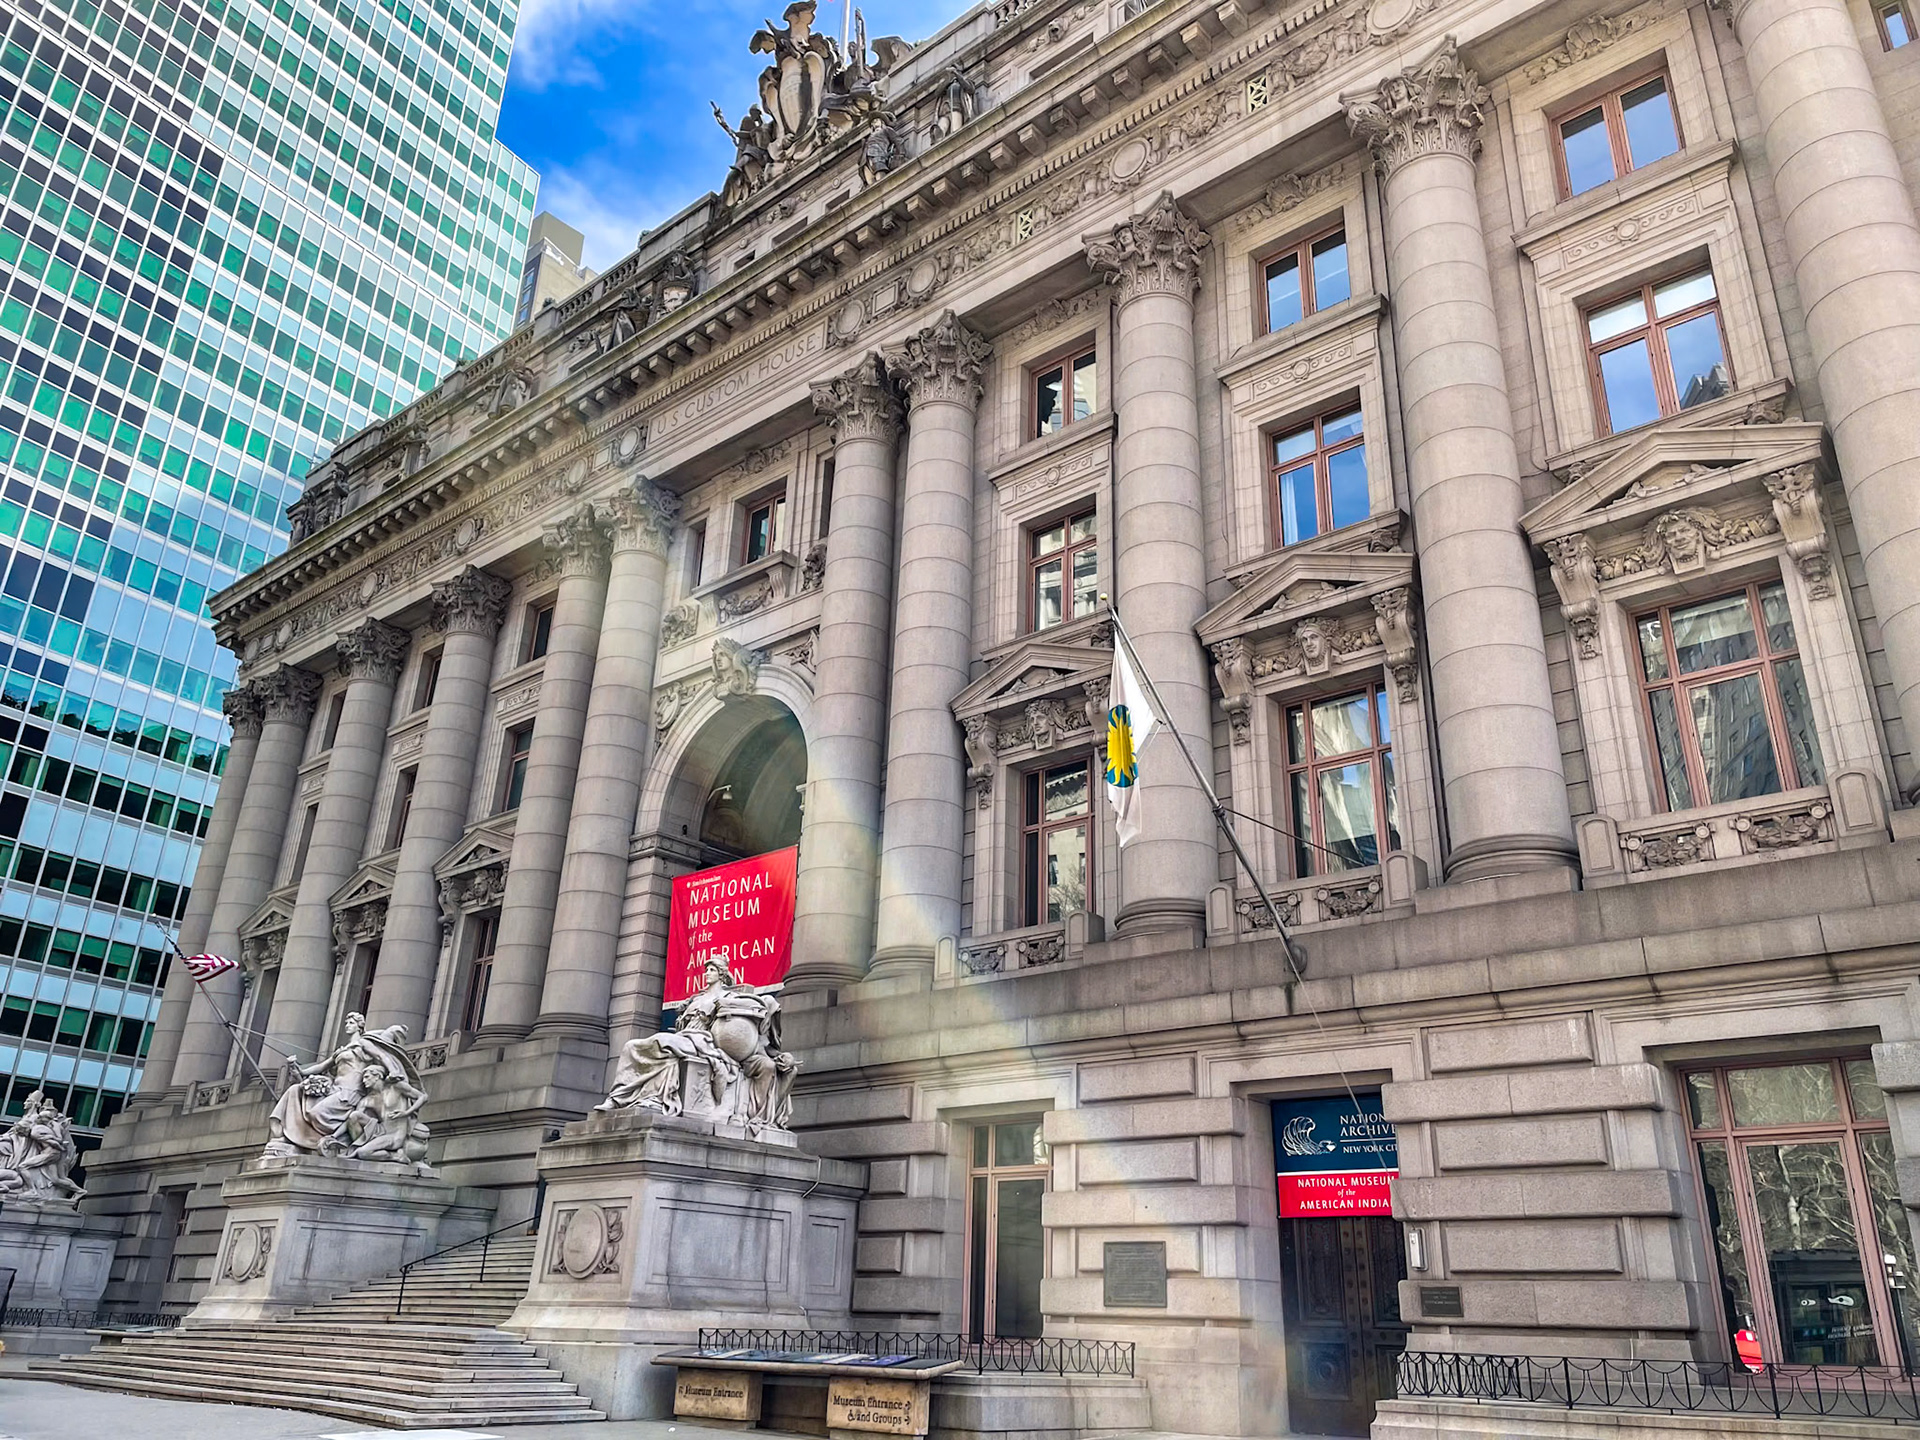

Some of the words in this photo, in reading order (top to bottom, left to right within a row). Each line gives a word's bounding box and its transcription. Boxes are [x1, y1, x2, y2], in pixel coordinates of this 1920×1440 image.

[684, 372, 749, 419] CUSTOM
[758, 333, 816, 379] HOUSE
[689, 871, 773, 906] NATIONAL
[688, 897, 760, 930] MUSEUM
[688, 930, 697, 949] of
[698, 929, 713, 944] the
[686, 936, 775, 970] AMERICAN
[685, 967, 745, 993] INDN
[1343, 1145, 1361, 1154] NEW
[1363, 1145, 1384, 1153] YORK
[1297, 1177, 1348, 1188] NATIONAL
[1351, 1175, 1395, 1187] MUSEUM
[1337, 1188, 1344, 1198] of
[1345, 1188, 1356, 1196] the
[1300, 1199, 1354, 1210] AMERICAN
[1358, 1198, 1392, 1209] INDIA
[685, 1384, 712, 1397] Museum
[713, 1387, 744, 1399] Entrance
[833, 1395, 866, 1407] Museum
[867, 1397, 903, 1410] Entrance
[856, 1411, 871, 1423] and
[872, 1412, 902, 1427] Groups
